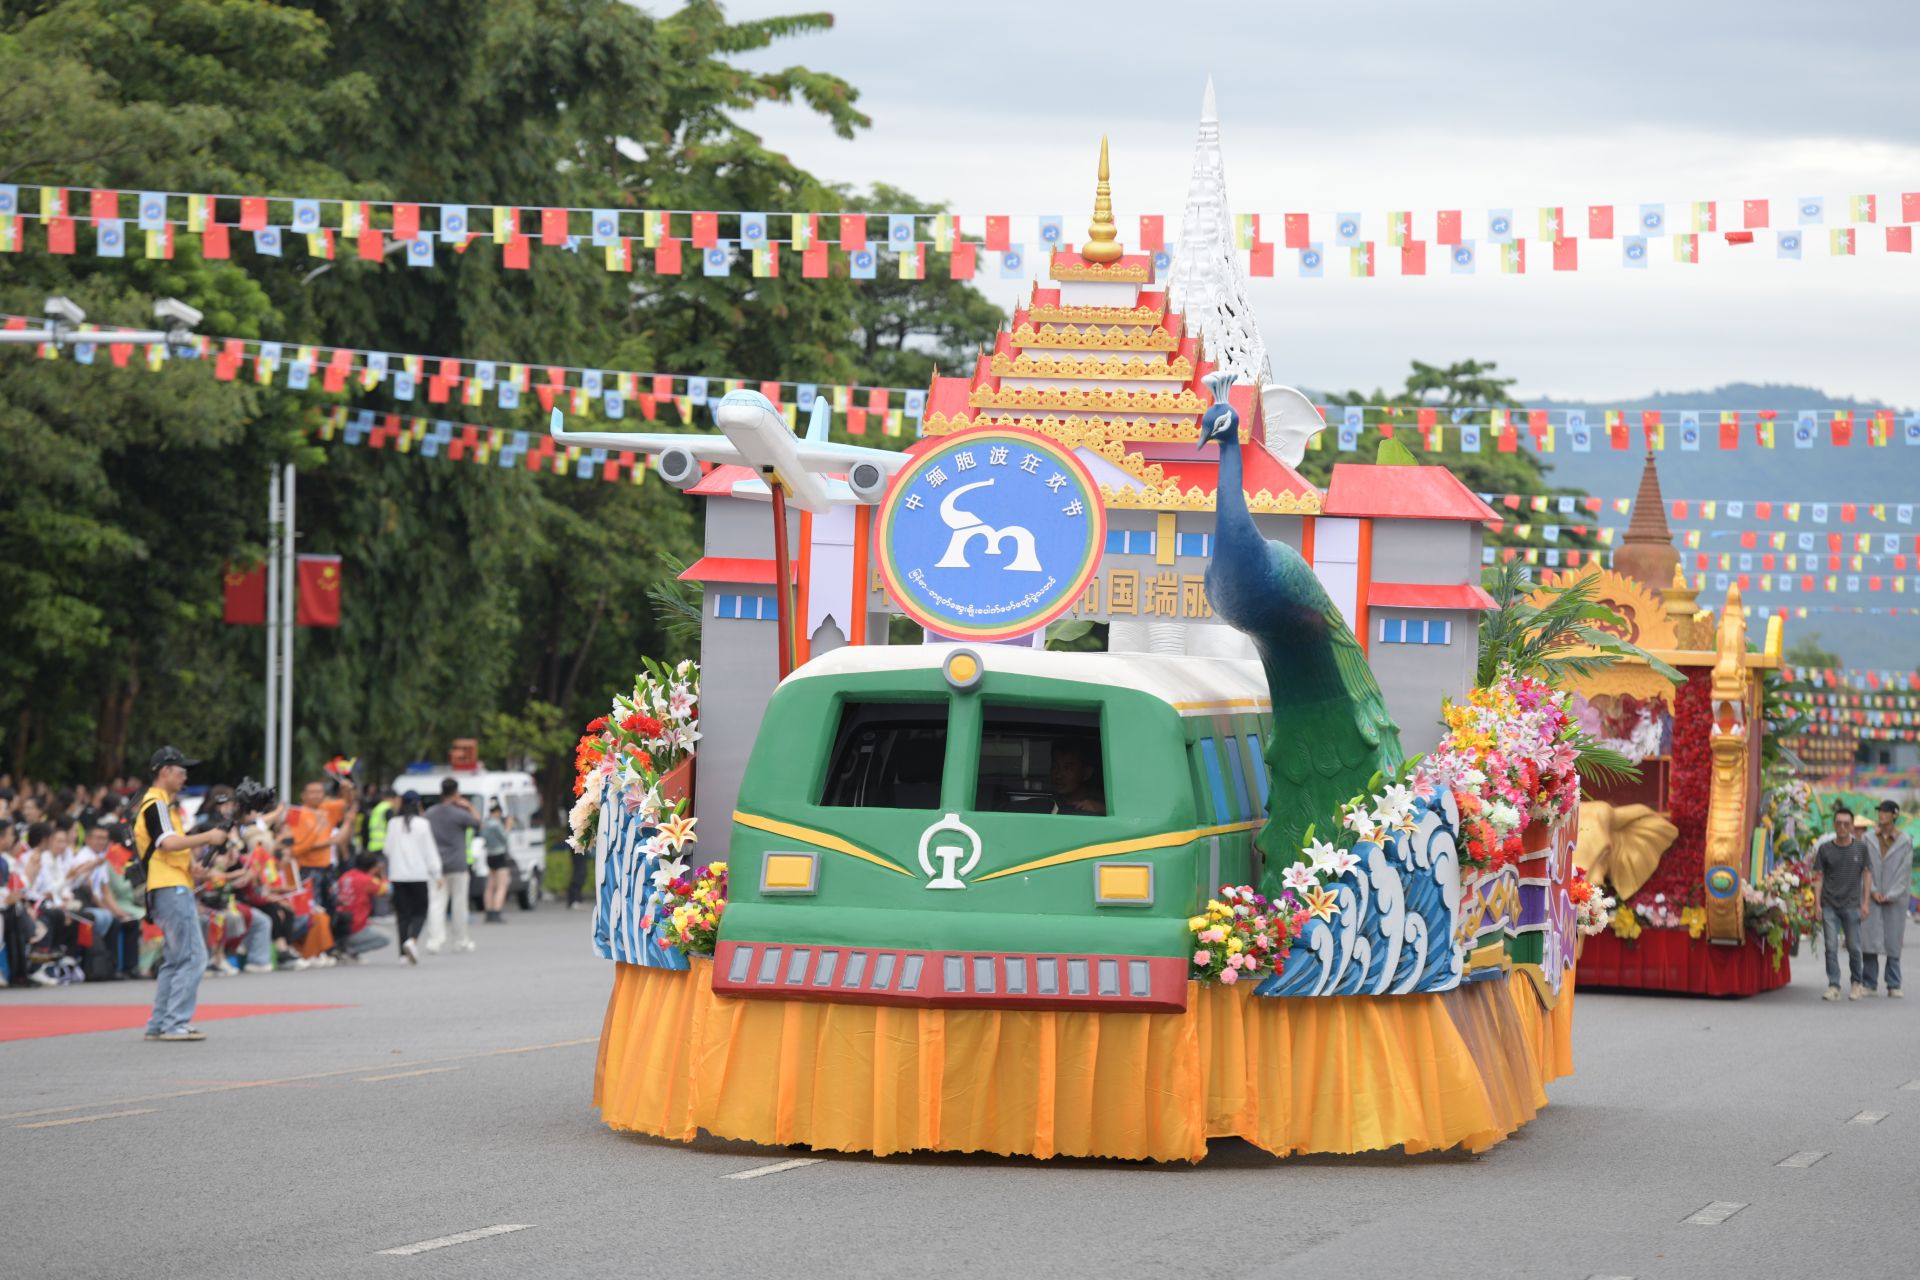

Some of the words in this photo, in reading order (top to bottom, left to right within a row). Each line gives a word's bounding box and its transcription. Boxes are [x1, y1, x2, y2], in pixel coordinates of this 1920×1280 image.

[904, 446, 1084, 518] 中缅胞波狂欢节
